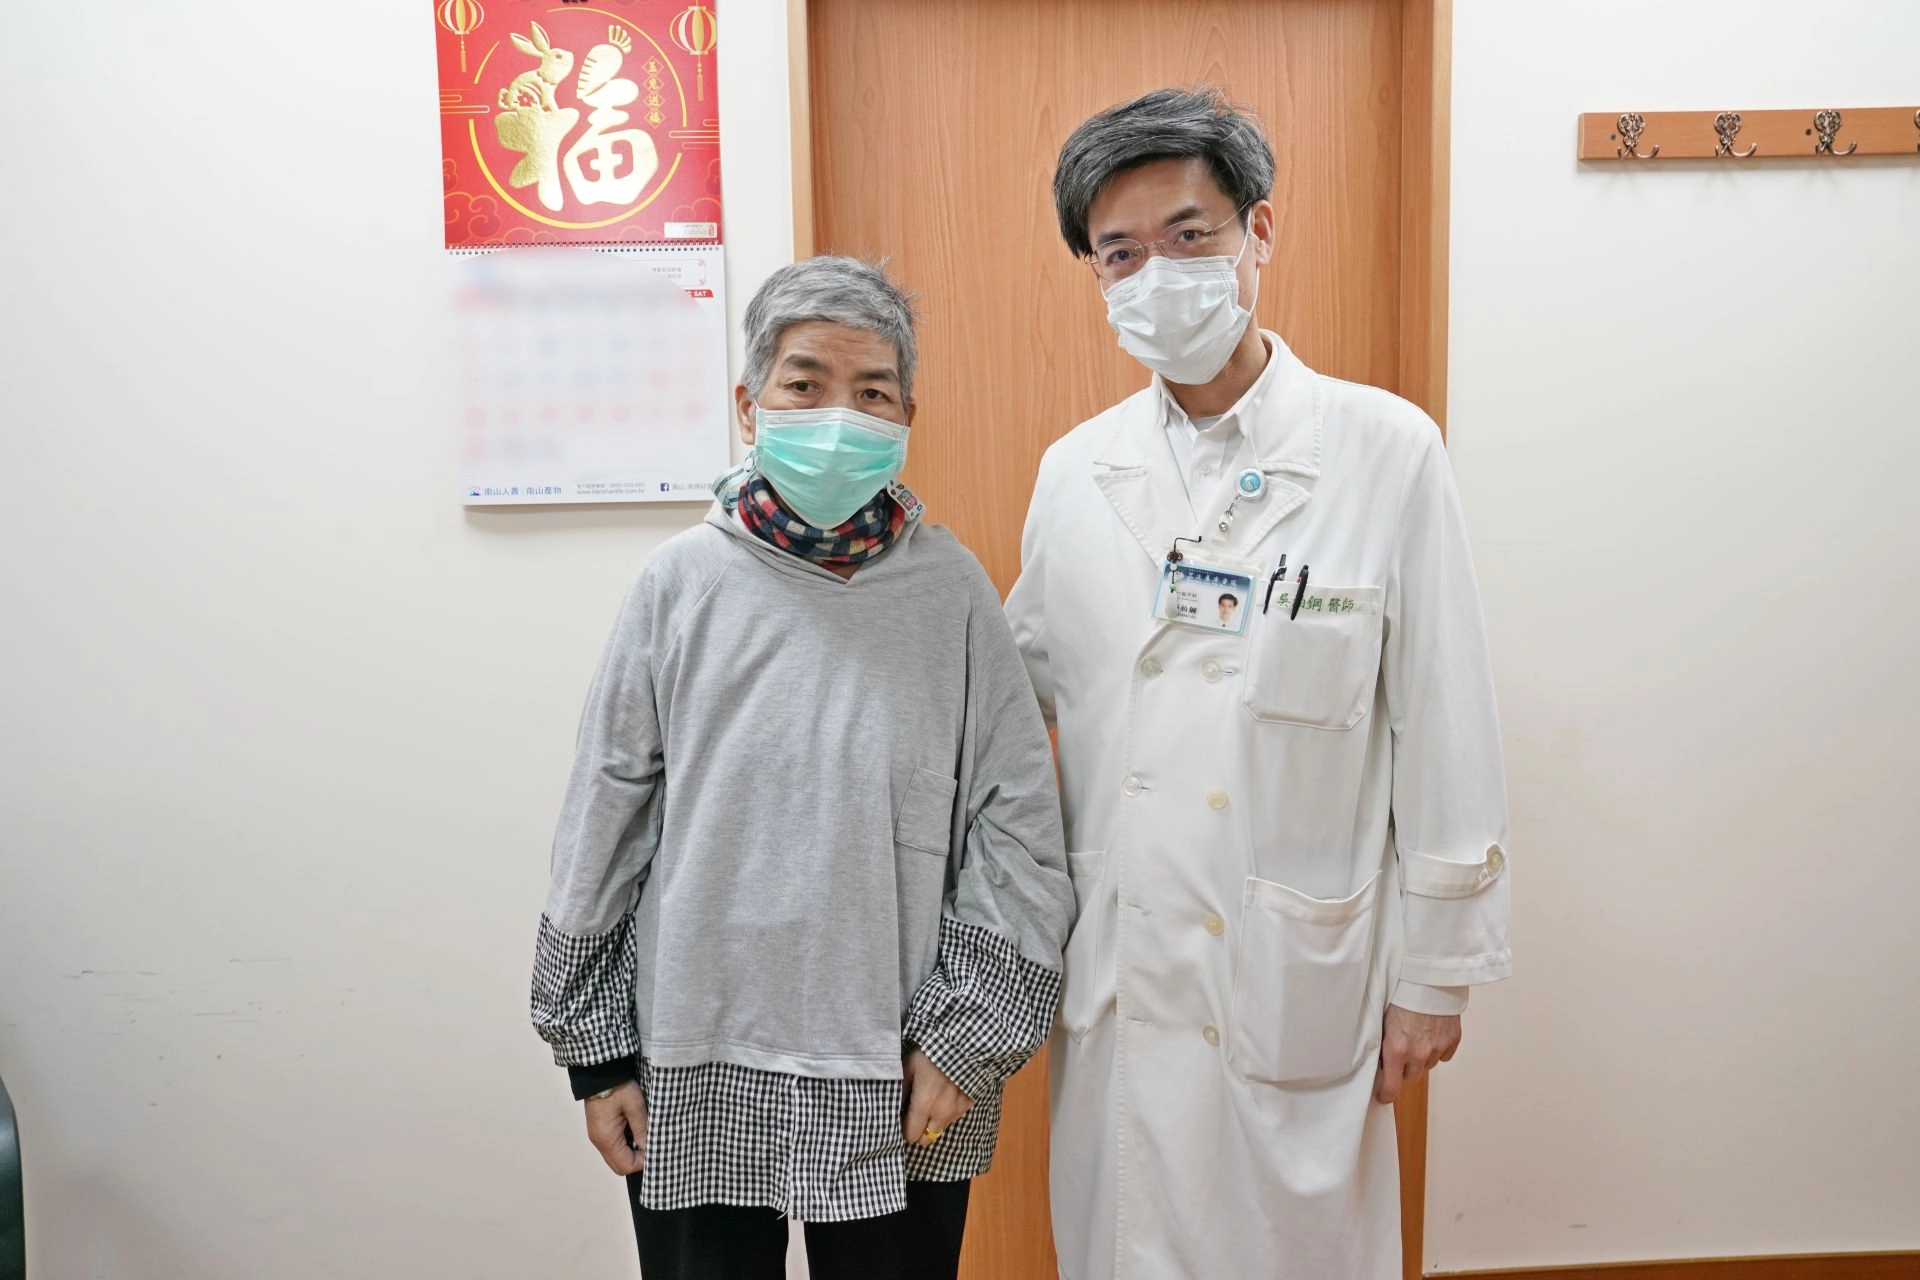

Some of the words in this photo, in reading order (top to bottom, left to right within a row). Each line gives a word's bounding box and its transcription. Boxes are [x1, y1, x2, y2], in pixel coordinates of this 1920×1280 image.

[494, 22, 659, 212] 福
[526, 486, 562, 495] 南山產物
[1328, 597, 1354, 613] 醫師
